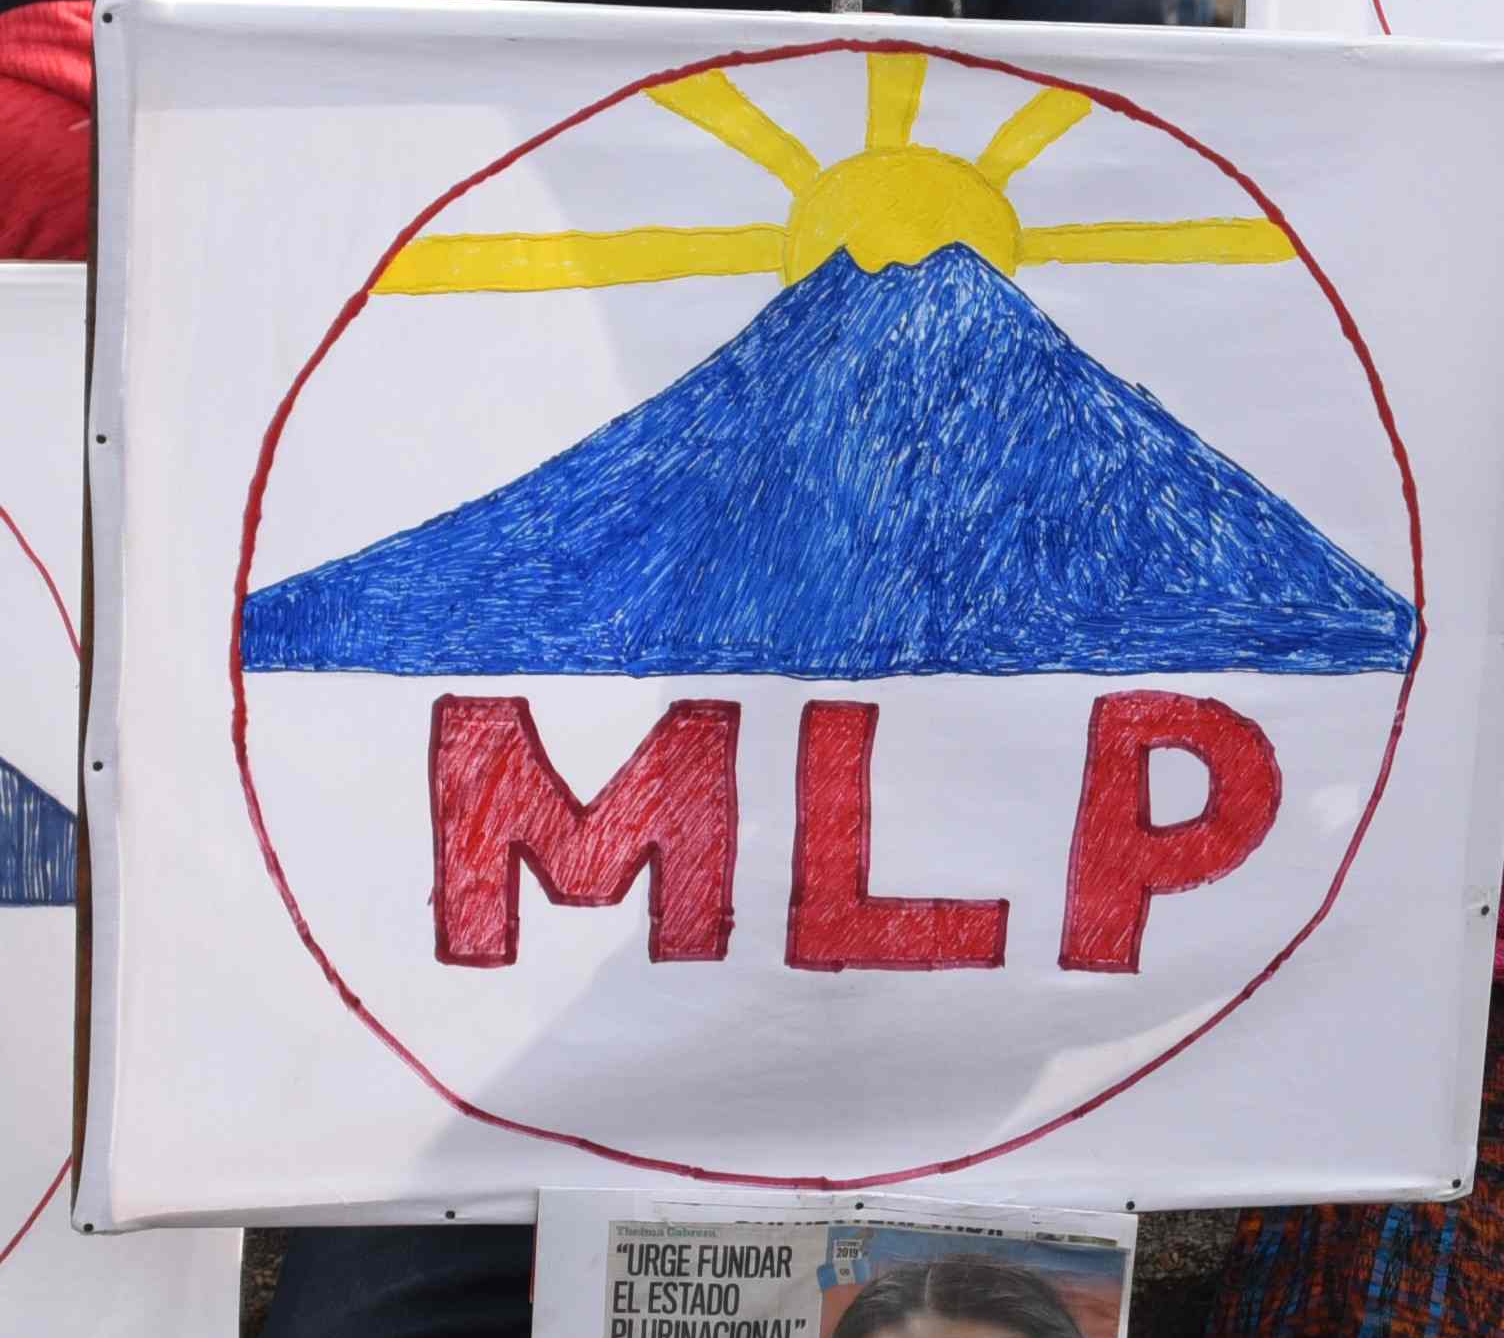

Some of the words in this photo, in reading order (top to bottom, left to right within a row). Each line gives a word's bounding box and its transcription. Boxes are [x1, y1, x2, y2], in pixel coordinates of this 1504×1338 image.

[432, 692, 1280, 971] MLP
[616, 1243, 692, 1277] “URGE
[697, 1245, 793, 1279] FUNDAR
[612, 1281, 641, 1314] EL
[647, 1281, 740, 1316] ESTADO
